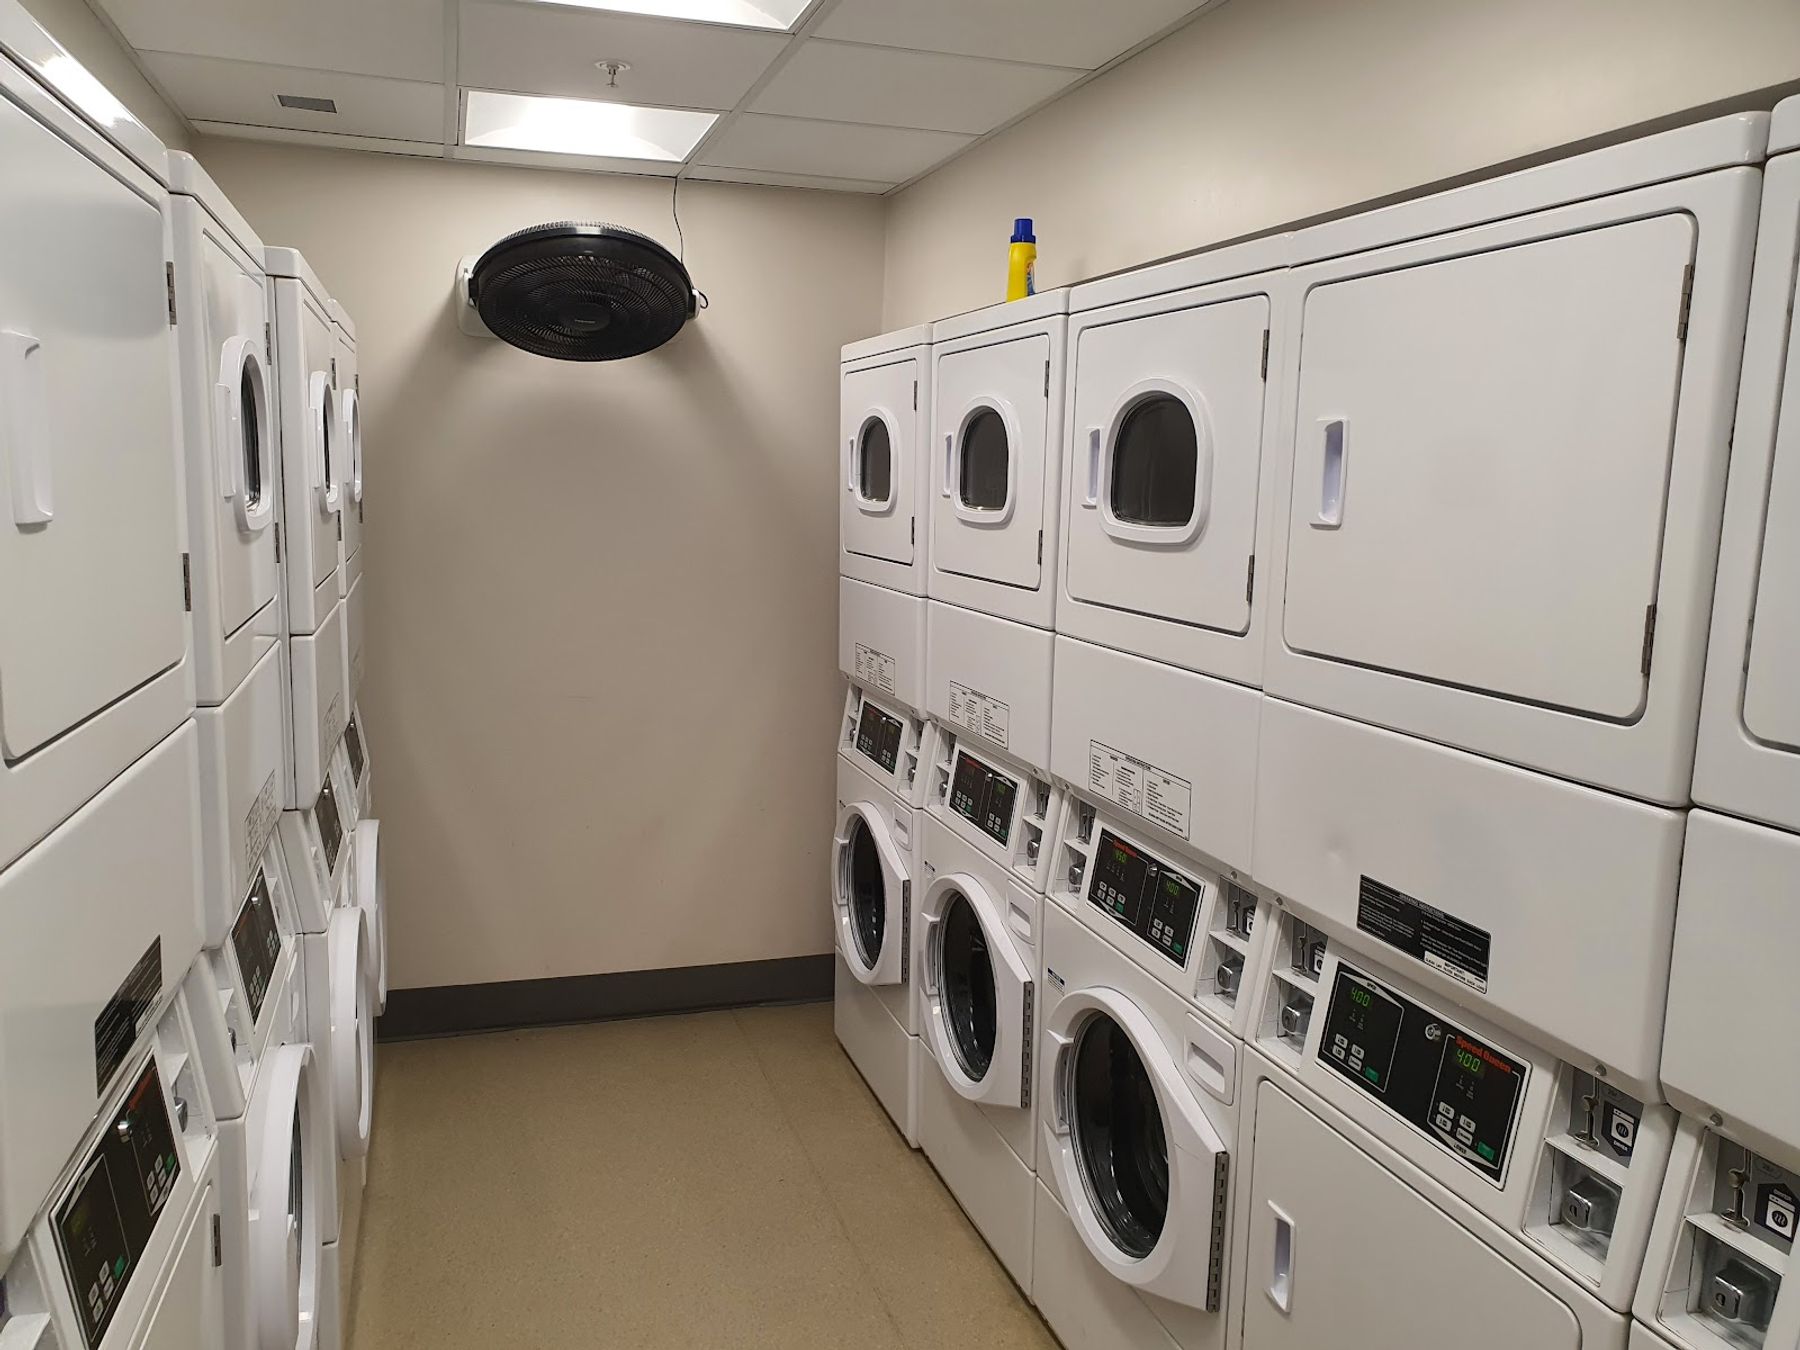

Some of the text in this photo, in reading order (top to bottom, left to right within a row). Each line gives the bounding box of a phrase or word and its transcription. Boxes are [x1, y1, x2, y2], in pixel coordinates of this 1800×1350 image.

[1455, 1034, 1512, 1073] Speed Queen
[1456, 1049, 1481, 1072] 400
